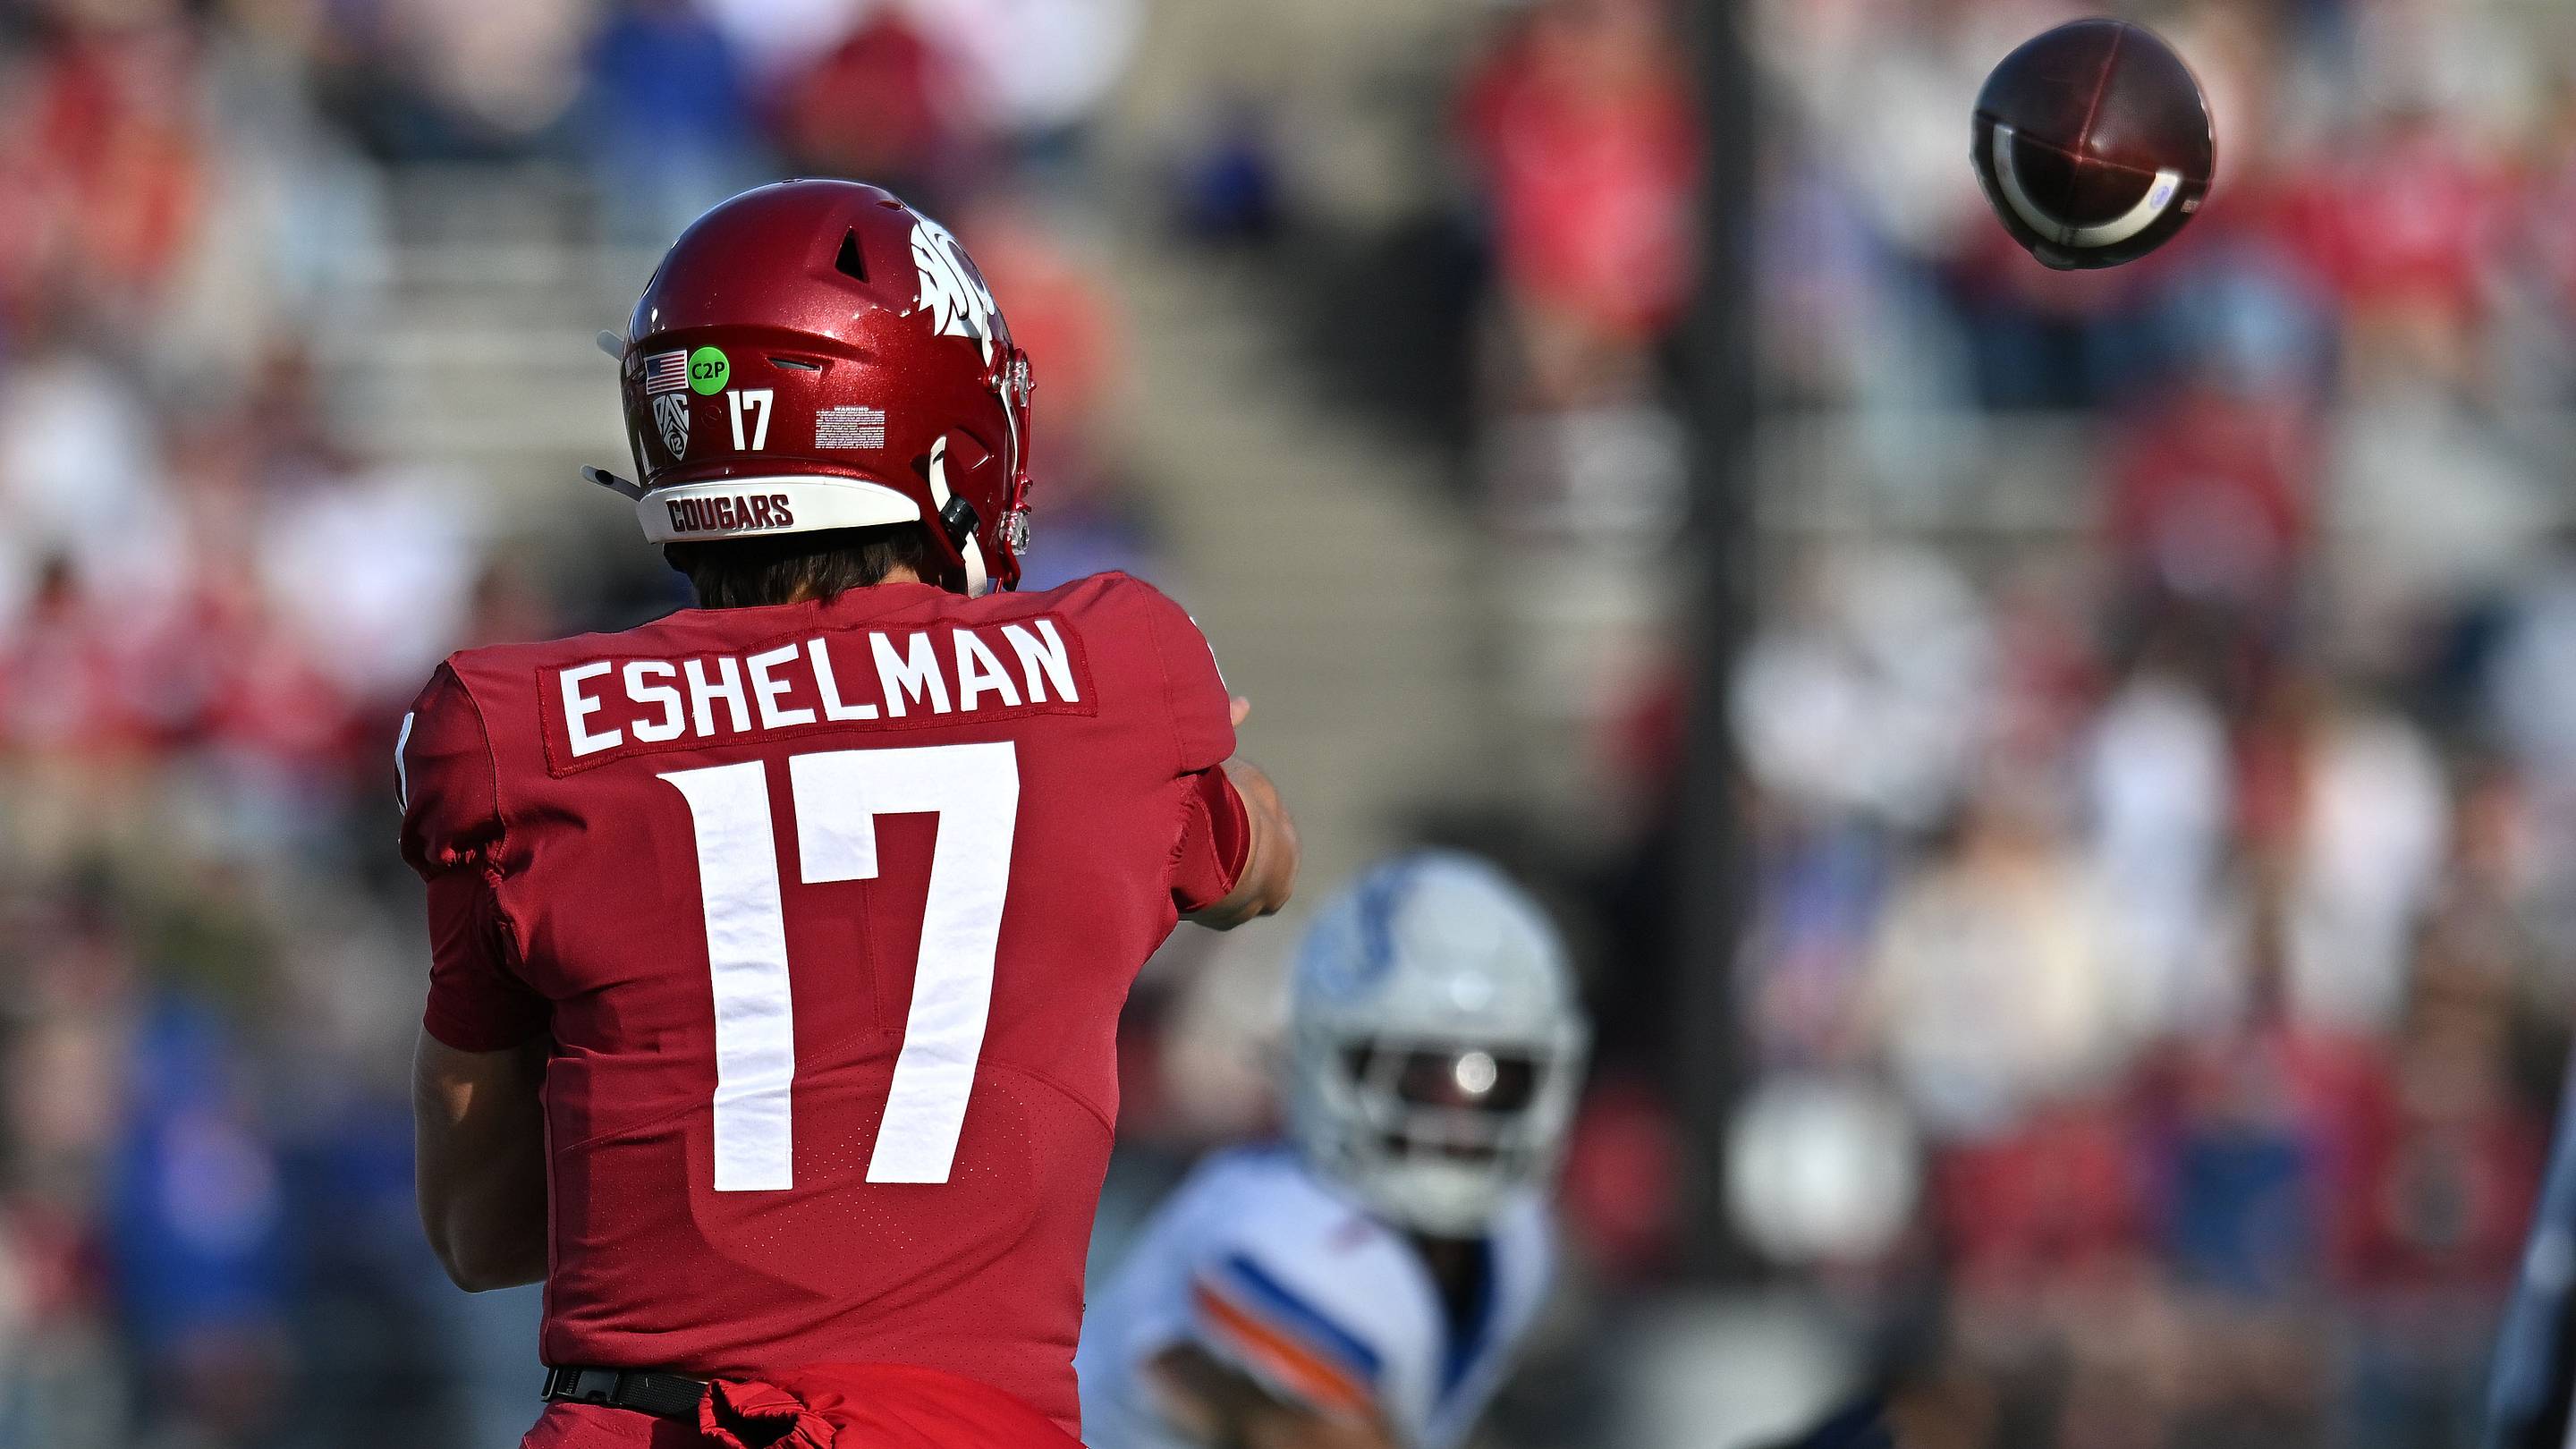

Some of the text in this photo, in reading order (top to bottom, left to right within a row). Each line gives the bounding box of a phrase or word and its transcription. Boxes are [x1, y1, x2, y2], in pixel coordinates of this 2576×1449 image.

[691, 361, 725, 380] C2P
[726, 388, 774, 451] 17
[665, 494, 794, 532] COUGARS
[559, 619, 1079, 757] ESHELMAN
[657, 741, 1020, 1192] 17
